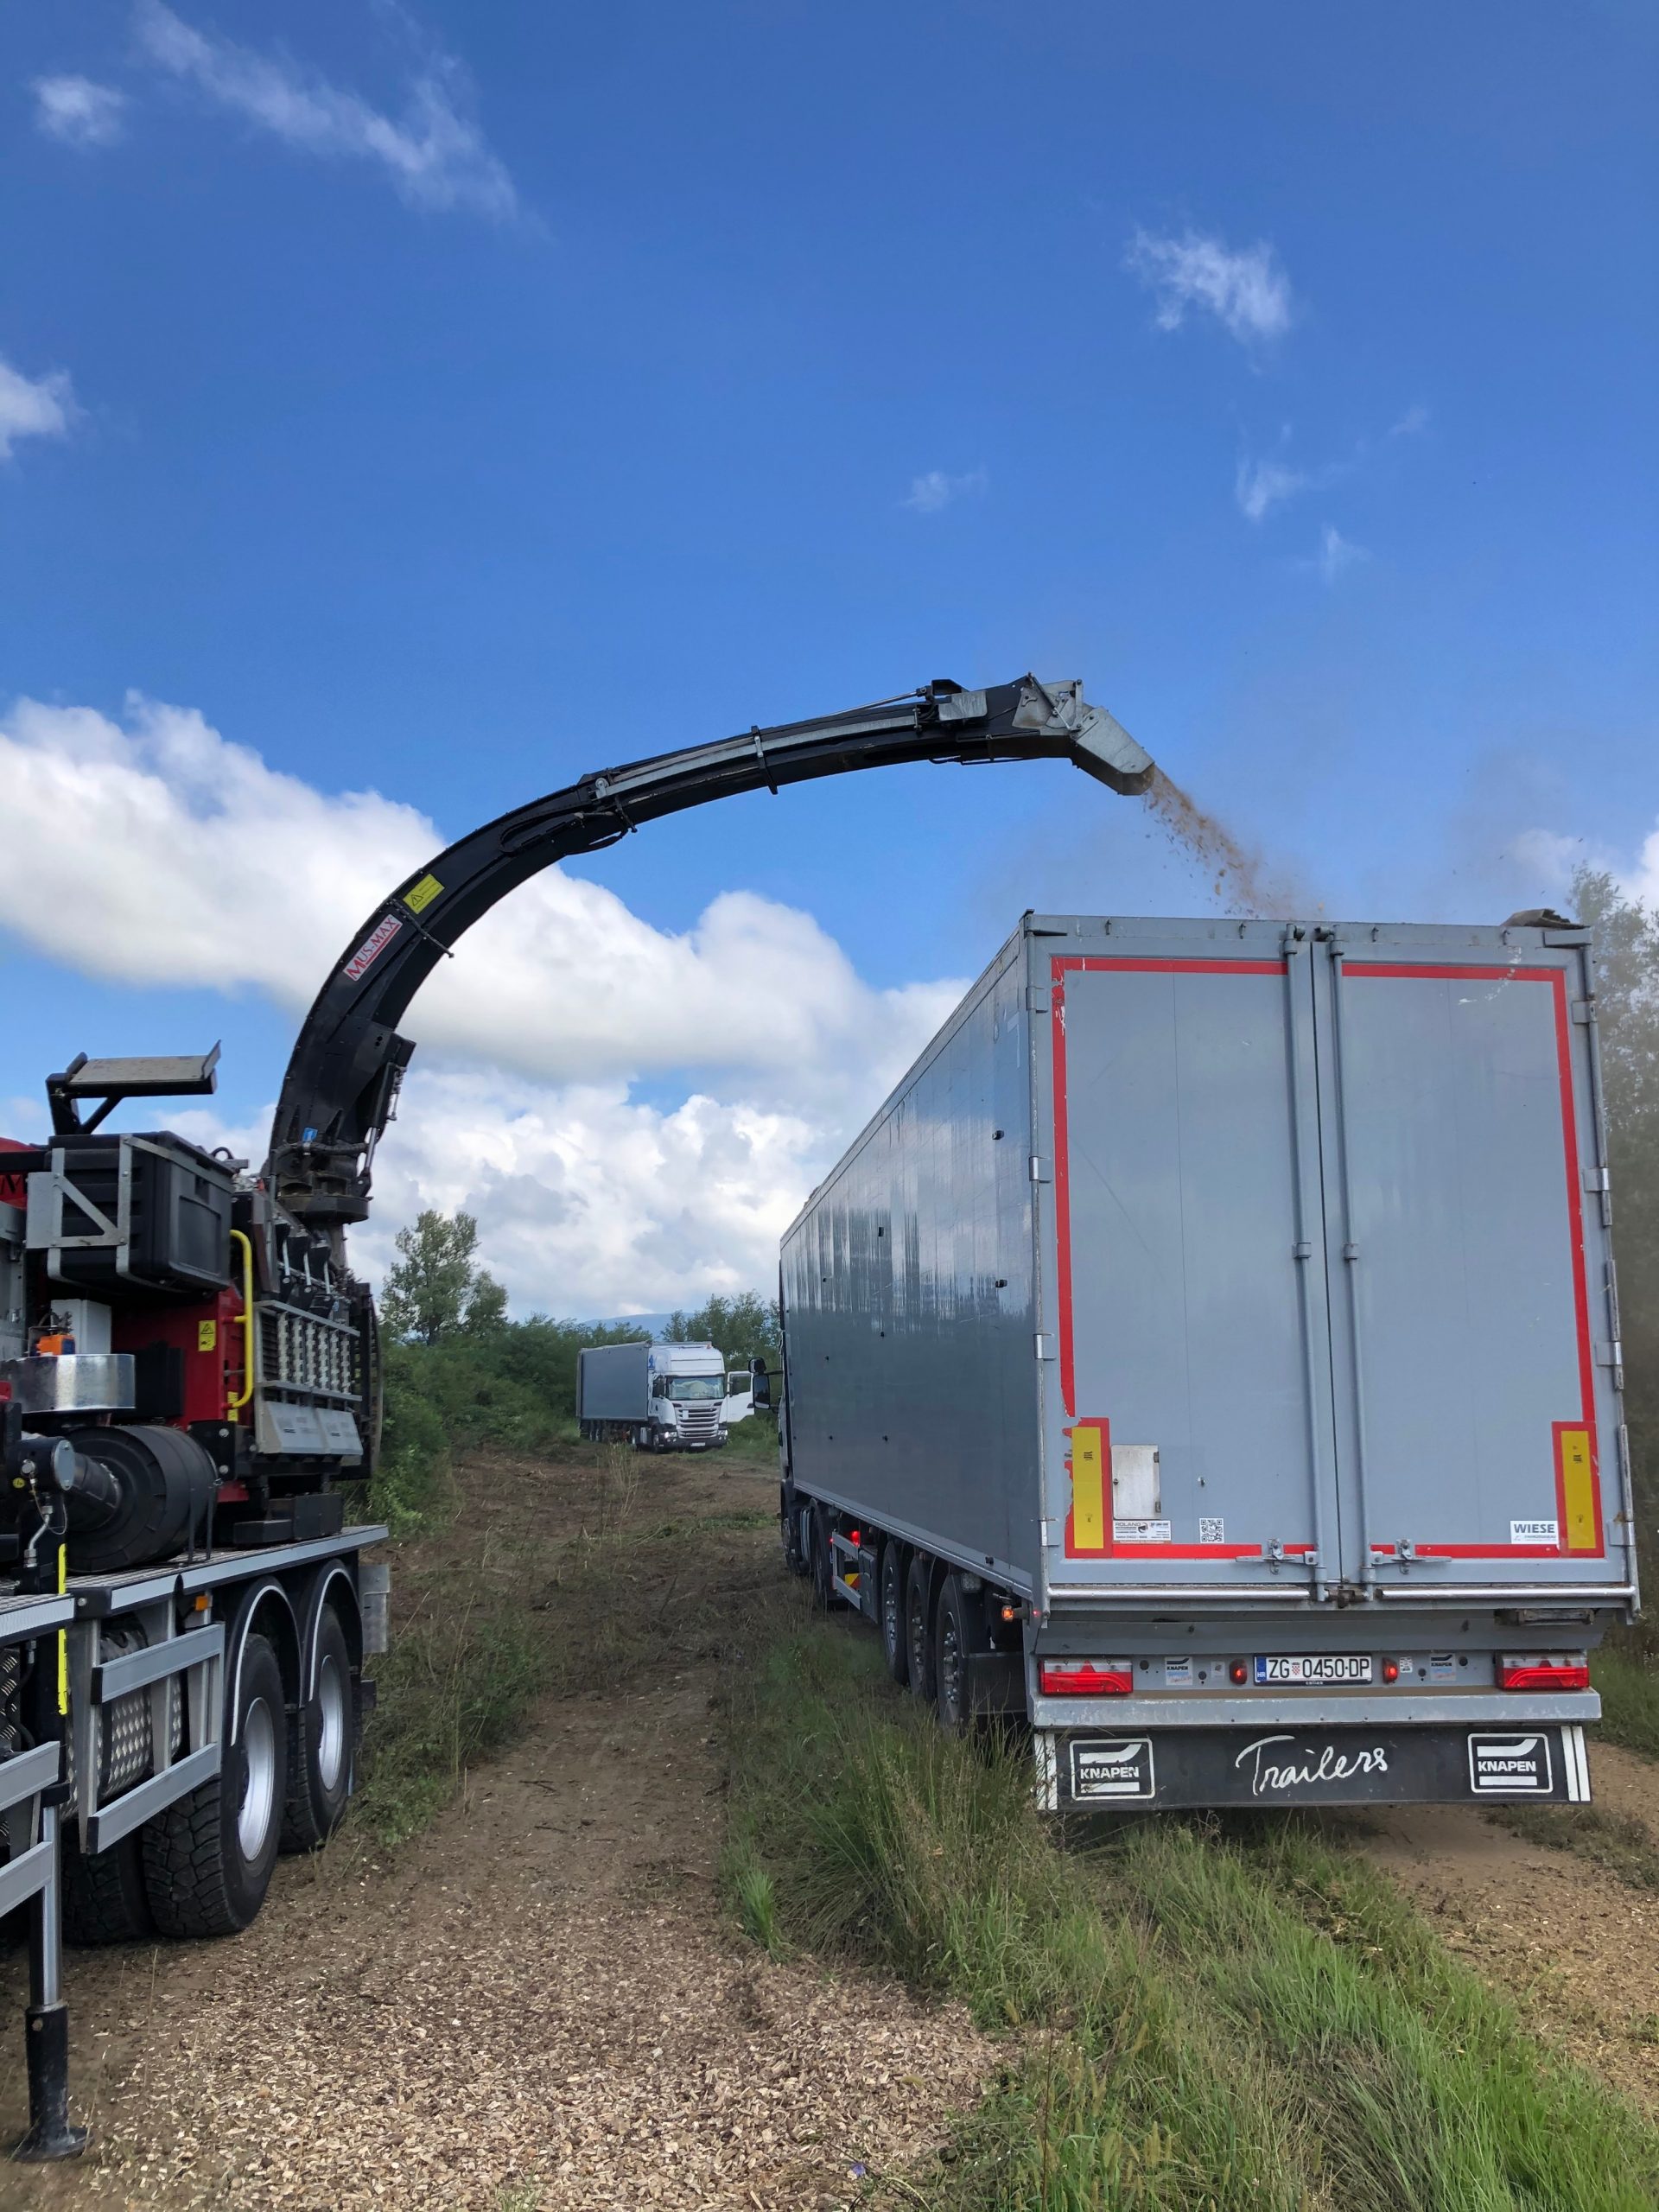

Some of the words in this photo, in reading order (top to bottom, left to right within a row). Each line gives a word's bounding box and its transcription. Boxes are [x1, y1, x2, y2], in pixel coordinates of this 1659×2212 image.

[346, 917, 397, 979] MUS-MAX
[1513, 1523, 1555, 1534] WIESE
[1268, 1659, 1290, 1679] ZG
[1080, 1766, 1140, 1780] KNAPEN
[1235, 1734, 1389, 1796] Trailers
[1477, 1760, 1537, 1772] KNAPEN
